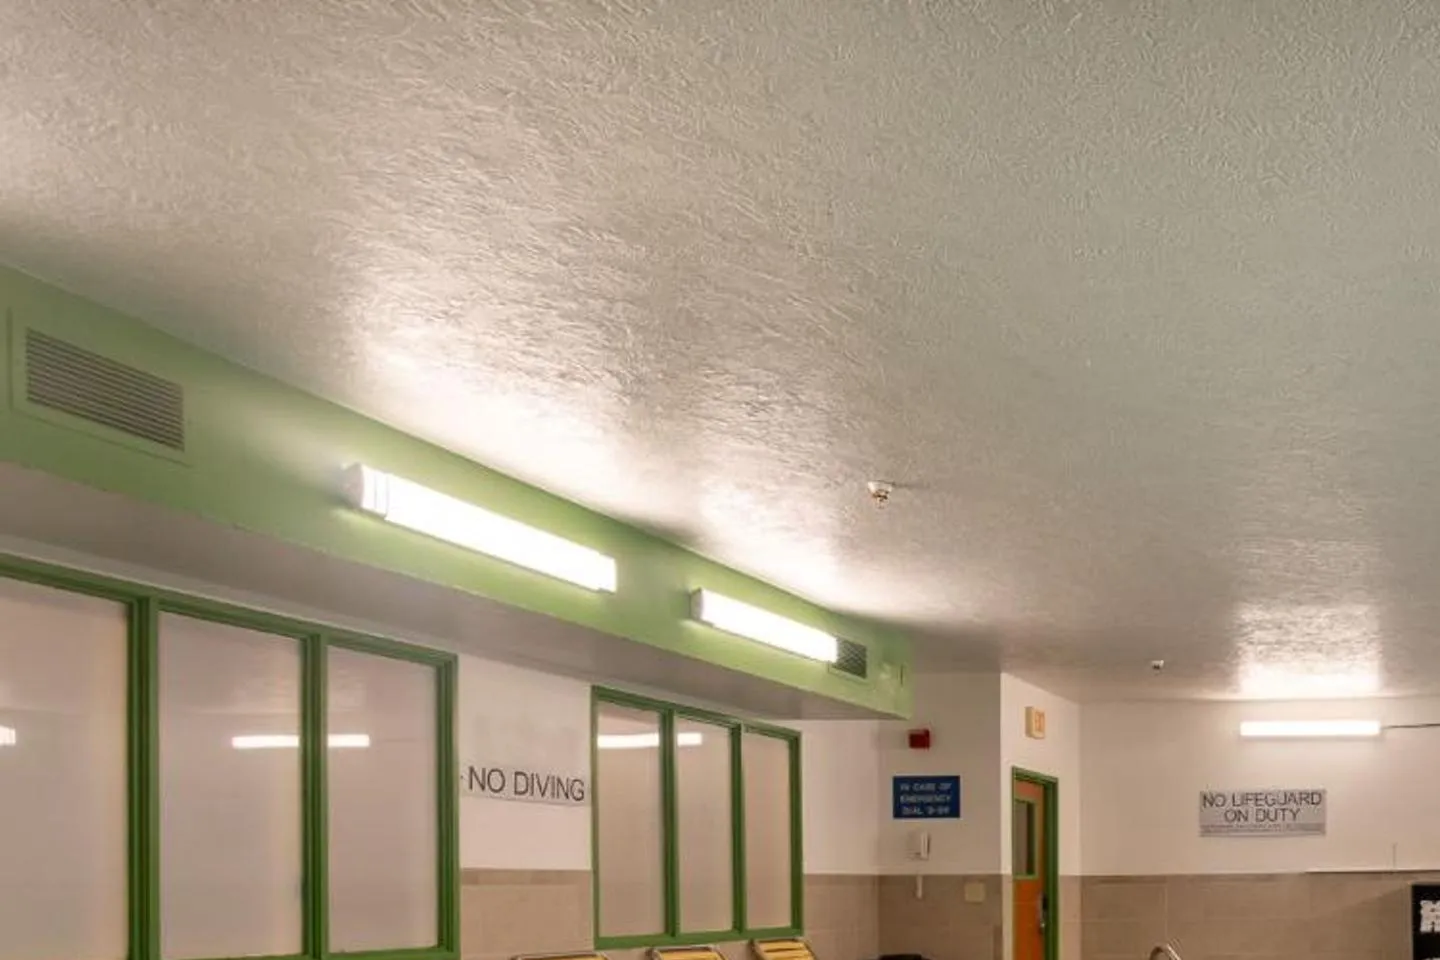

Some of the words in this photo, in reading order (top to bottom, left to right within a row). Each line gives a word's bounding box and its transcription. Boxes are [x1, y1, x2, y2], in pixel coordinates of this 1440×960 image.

[468, 766, 506, 794] NO
[513, 771, 585, 802] DIVING
[1202, 793, 1227, 809] NO
[1232, 791, 1323, 807] LIFEGUARD
[1224, 808, 1249, 823] ON
[1255, 807, 1301, 823] DUTY
